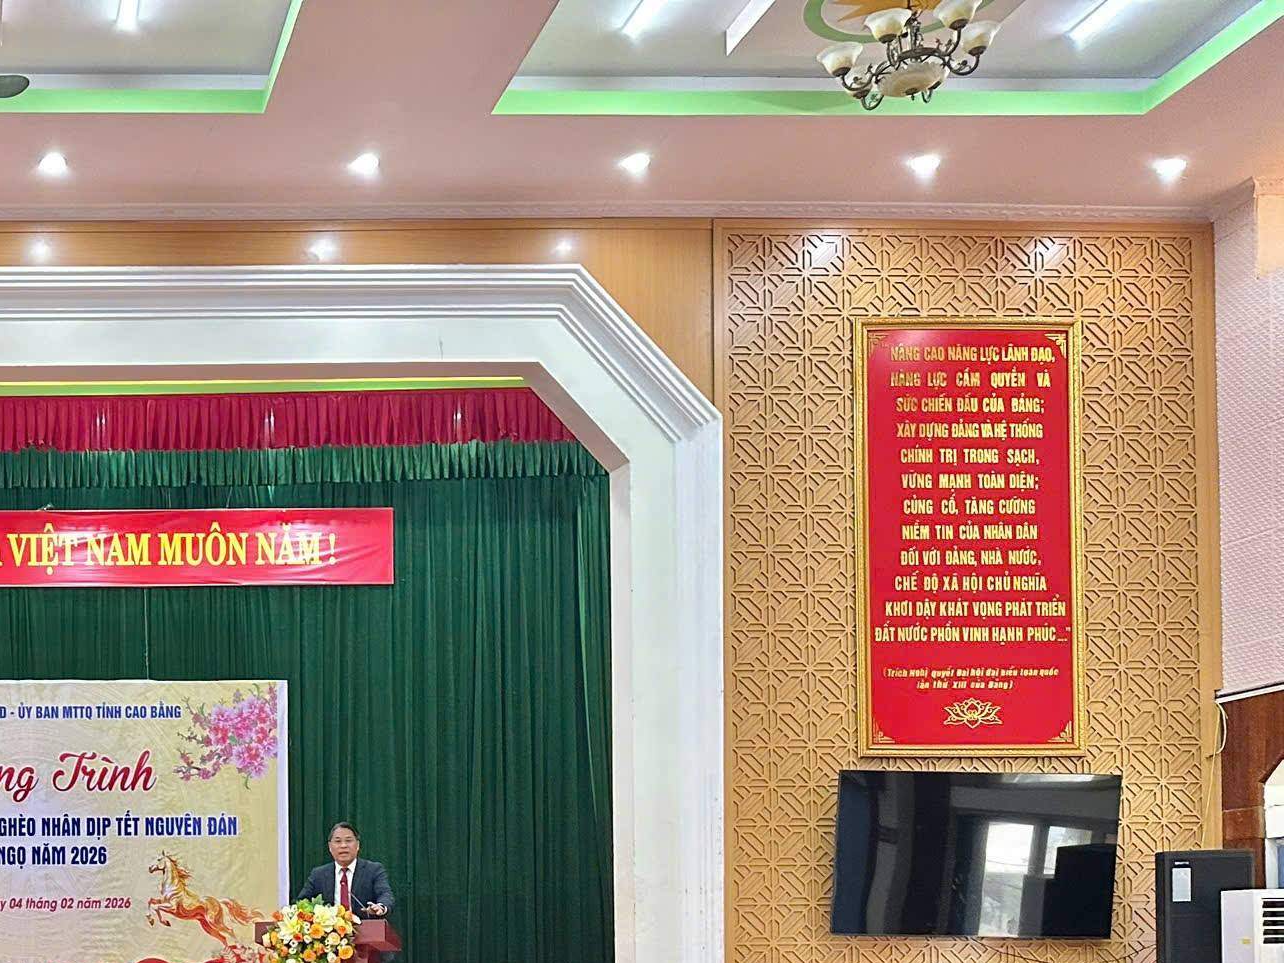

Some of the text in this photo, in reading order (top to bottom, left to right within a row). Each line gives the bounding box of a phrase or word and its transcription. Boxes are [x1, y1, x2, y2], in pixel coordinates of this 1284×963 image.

[924, 344, 1028, 365] CAO NĂNG LỰC LÃNH
[928, 369, 1051, 389] LỰC VÀ
[896, 392, 1044, 413] SỨC CHIẾN ĐẤU CỦA ĐẢNG;
[897, 418, 1043, 441] XÂY DỰNG ĐẢNG THỐNG
[901, 444, 1039, 466] CHÍNH TRỊ TRONG SẠCH,
[902, 470, 1038, 492] VỮNG MẠNH TOÀN DIỆN;
[904, 493, 994, 515] CỦNG CỐ, TĂNG
[935, 520, 1037, 540] TIN CỦA NHÂN DÂN
[7, 523, 80, 575] VIỆT
[86, 533, 151, 566] NAM
[158, 521, 248, 566] MUÔN
[901, 545, 1003, 567] ĐỐI VỚI ĐẢNG, NHÀ
[895, 570, 1047, 593] CHẾ ĐỘ XÃ HỘI CHỦ NGHĨA
[886, 594, 1066, 619] KHƠI DẬY KHÁT VỌNG PHÁT TRIỂN
[875, 621, 1023, 645] ĐẤT NƯỚC VINH HẠNH
[18, 701, 33, 719] ỦY
[36, 706, 59, 719] BAN
[62, 706, 92, 720] MTTQ
[95, 702, 121, 719] TỈNH
[125, 706, 147, 719] CAO
[151, 700, 181, 718] BẰNG
[52, 750, 157, 793] Trình
[42, 813, 80, 836] NHÂN
[86, 817, 111, 840] DỊP
[116, 810, 139, 836] TẾT
[145, 812, 202, 836] NGUYÊN
[208, 813, 237, 836] ĐÁN
[32, 843, 65, 865] NĂM
[71, 846, 107, 865] 2026
[9, 898, 23, 909] 04
[26, 897, 57, 912] tháng
[60, 898, 74, 909] 02
[77, 898, 101, 909] năm
[104, 898, 131, 909] 2026
